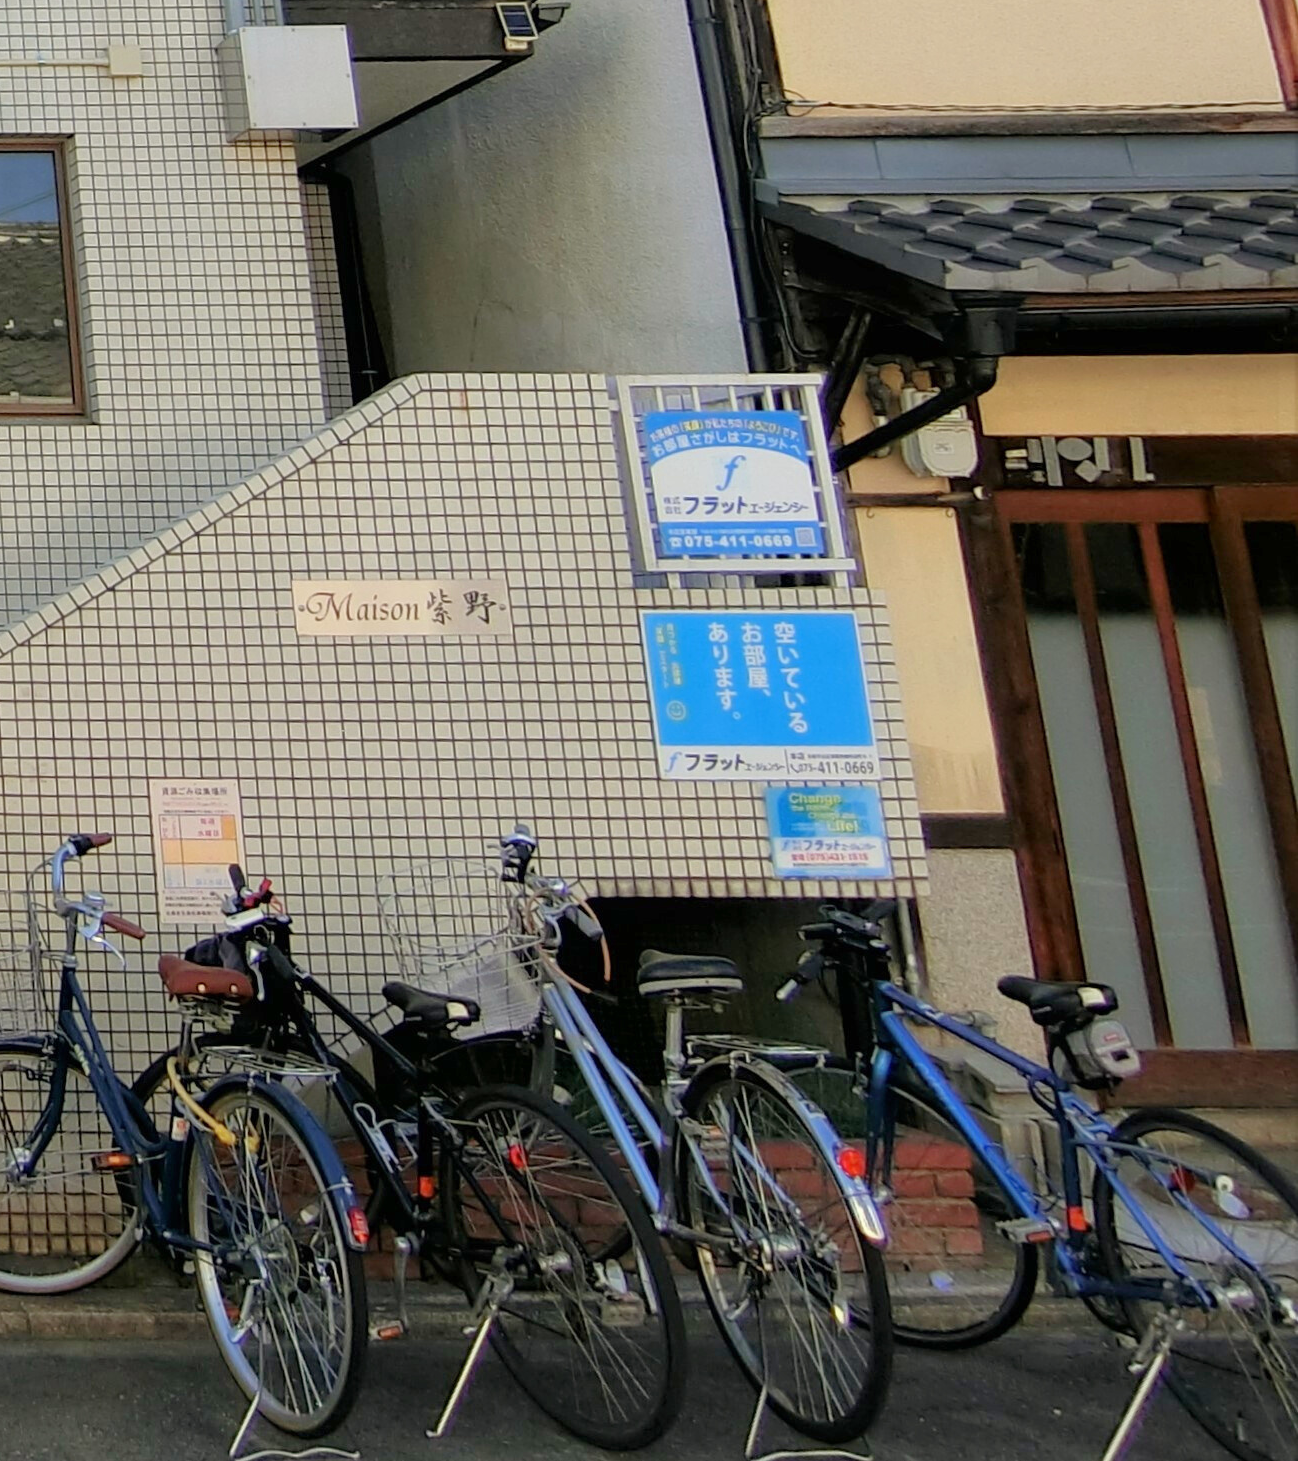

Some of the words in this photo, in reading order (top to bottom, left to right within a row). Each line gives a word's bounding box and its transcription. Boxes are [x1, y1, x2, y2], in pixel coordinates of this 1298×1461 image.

[684, 535, 793, 548] 075-411-0669
[306, 592, 419, 622] Maison
[427, 588, 497, 625] 紫野
[708, 622, 741, 719] あります。
[741, 622, 771, 696] お部屋、
[774, 622, 808, 733] 空いている
[789, 793, 841, 807] Change
